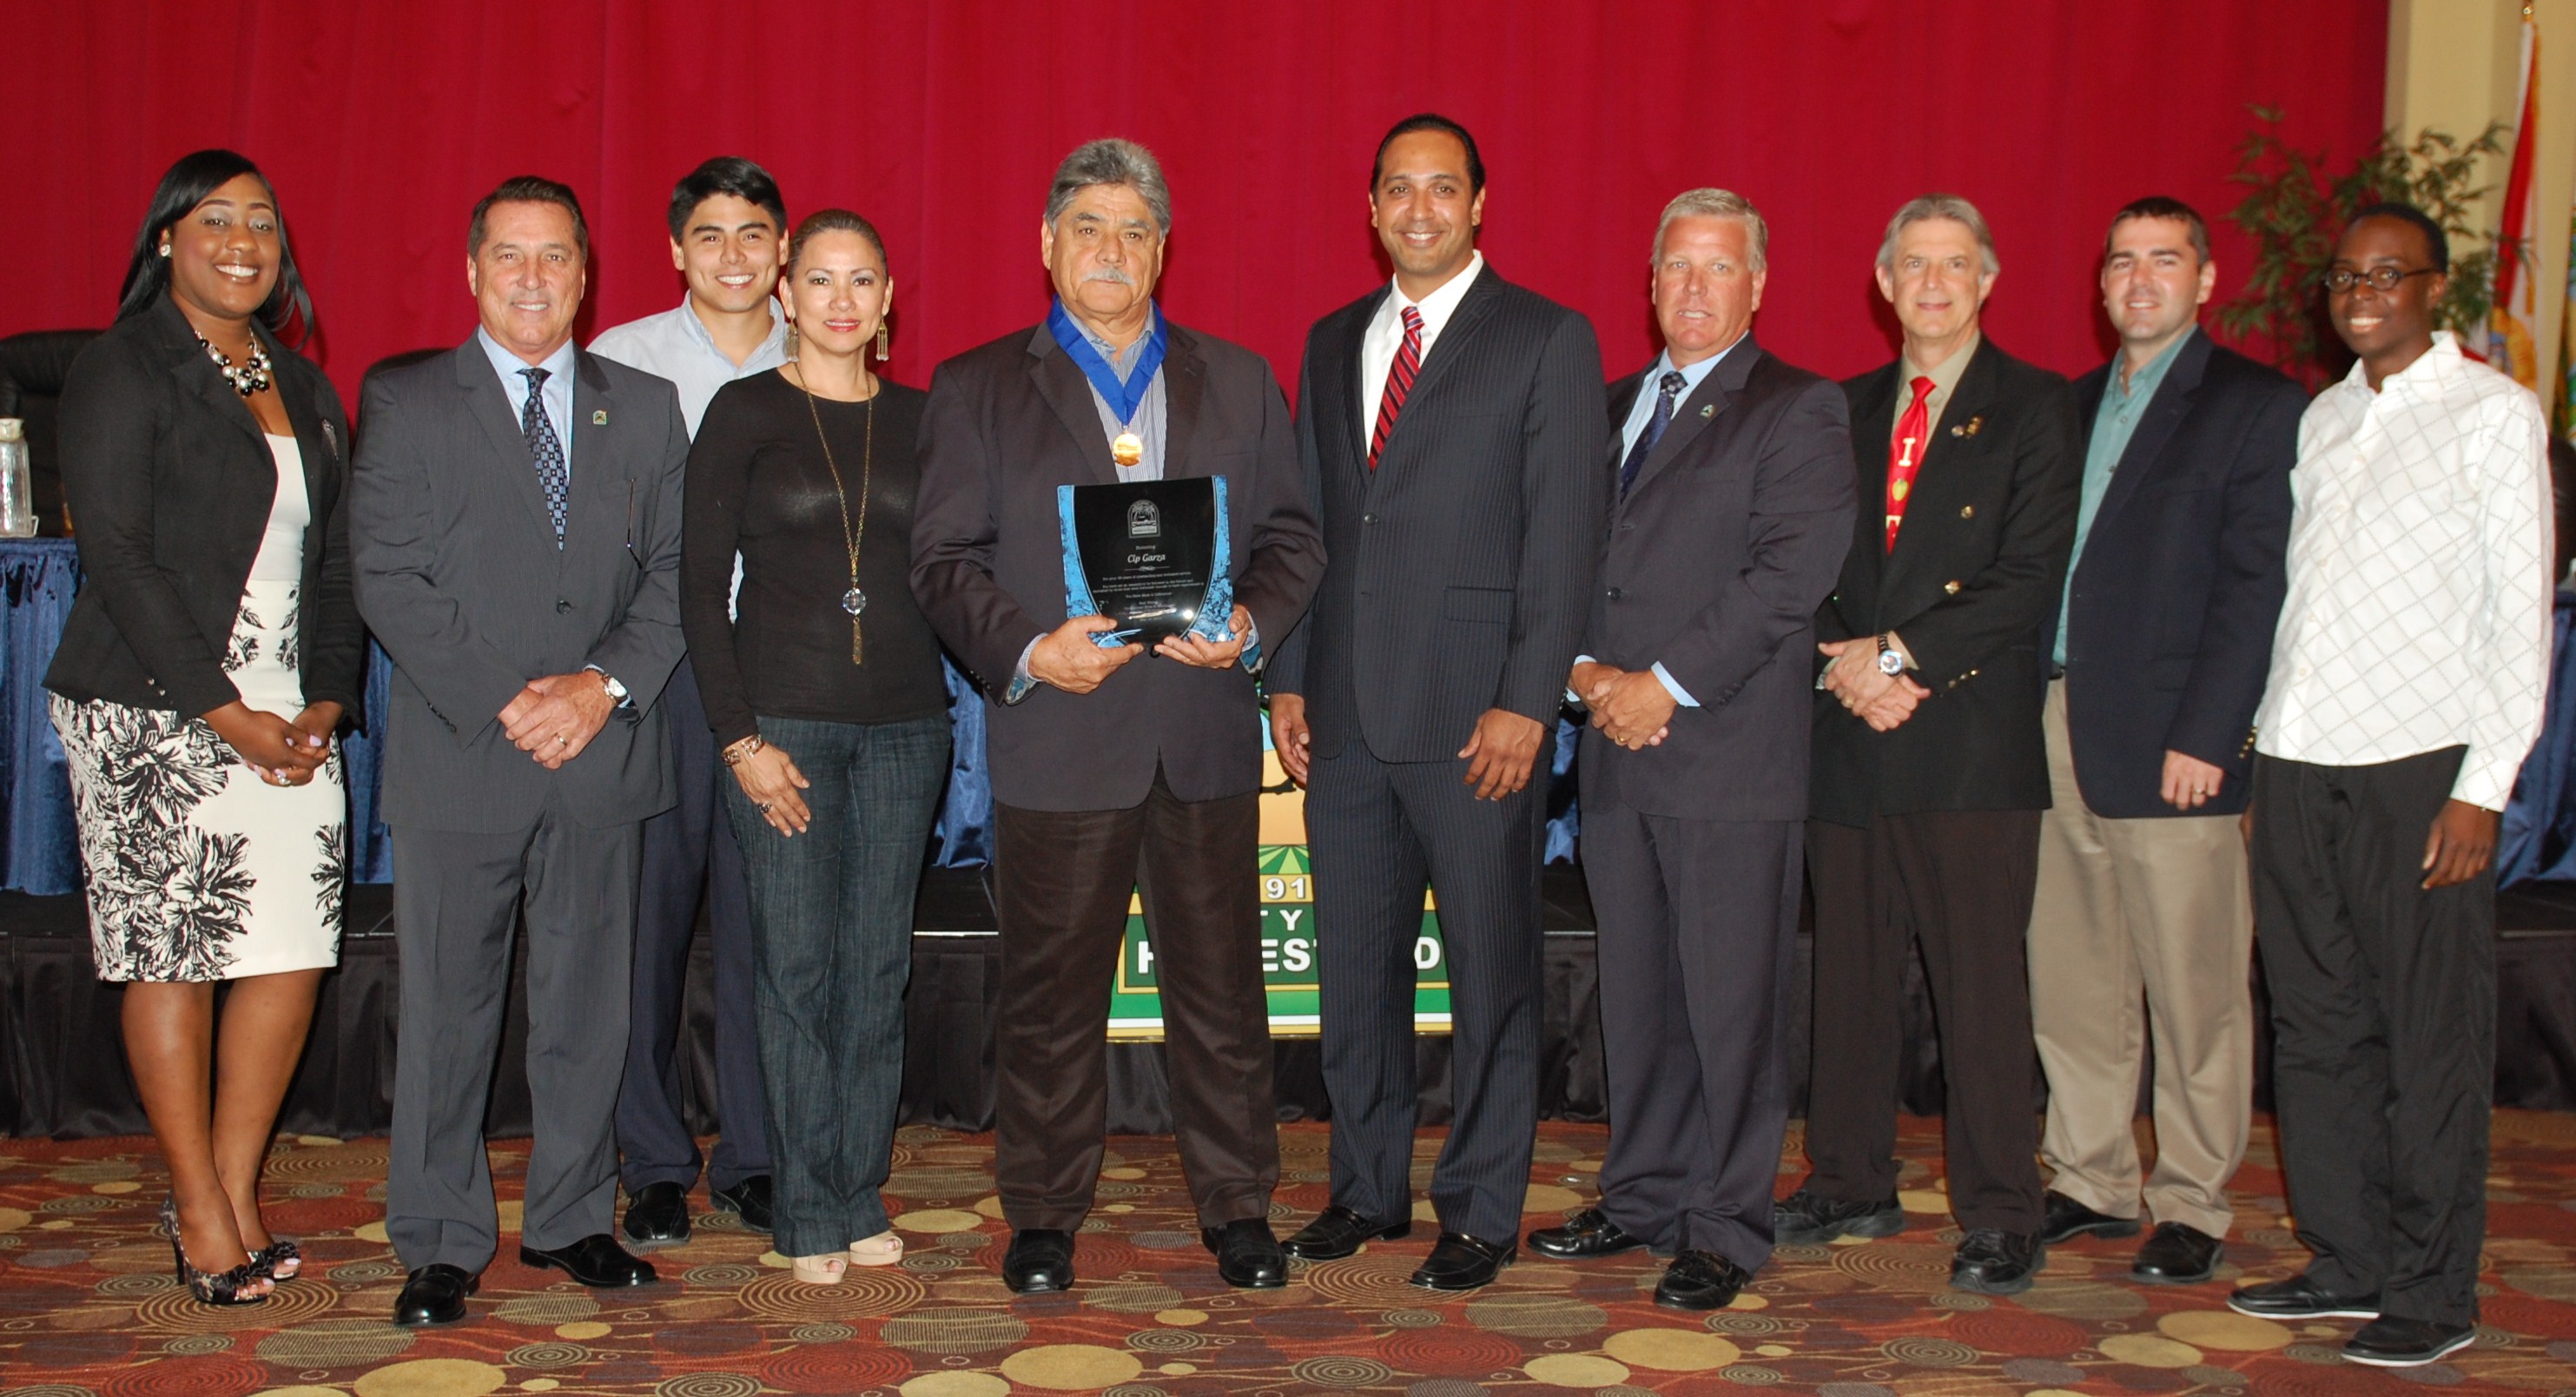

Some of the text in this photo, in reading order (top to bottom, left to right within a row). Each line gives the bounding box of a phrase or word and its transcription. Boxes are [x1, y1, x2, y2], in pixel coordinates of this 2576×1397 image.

[1899, 438, 1916, 467] I
[1127, 552, 1166, 564] Cip Garza
[1265, 877, 1305, 899] 91
